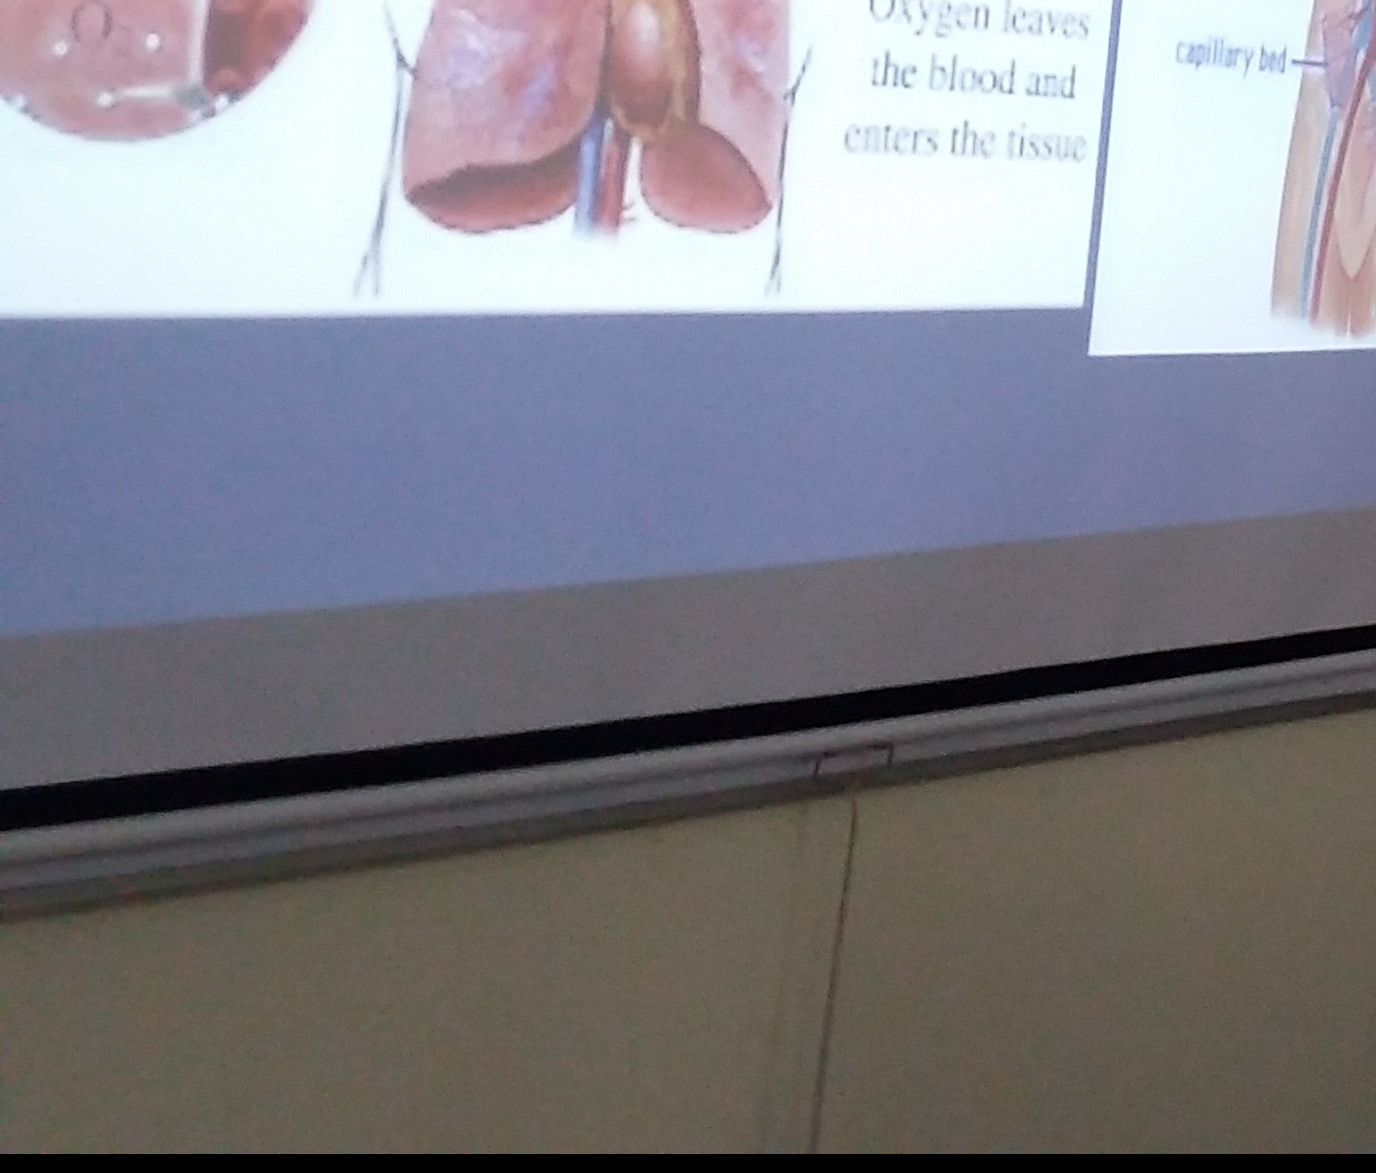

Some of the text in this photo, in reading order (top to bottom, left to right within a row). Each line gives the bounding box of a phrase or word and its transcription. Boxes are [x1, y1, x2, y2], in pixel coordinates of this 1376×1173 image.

[871, 49, 1077, 100] the blood and
[1176, 35, 1287, 79] capillary bed
[844, 118, 1087, 164] enters the tissue
